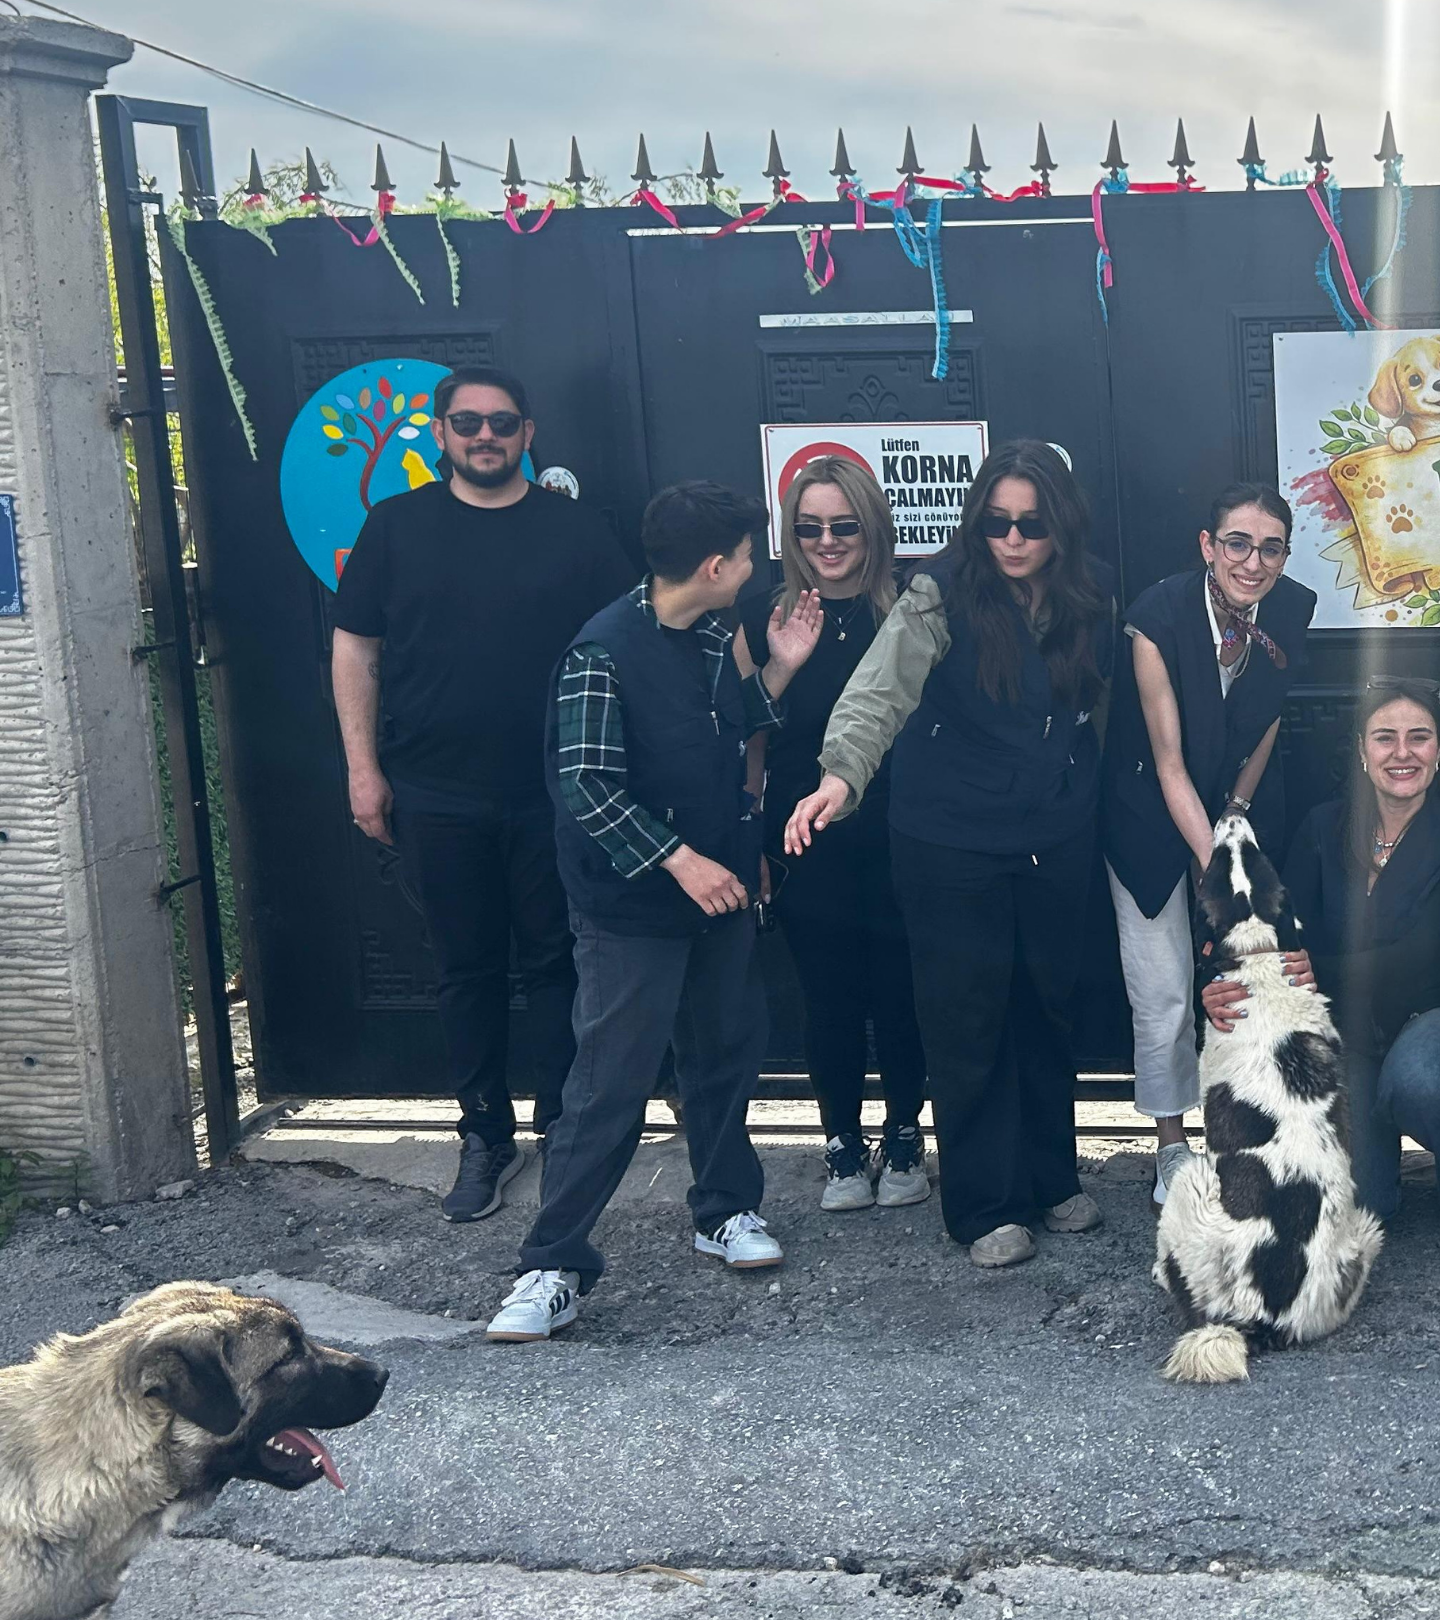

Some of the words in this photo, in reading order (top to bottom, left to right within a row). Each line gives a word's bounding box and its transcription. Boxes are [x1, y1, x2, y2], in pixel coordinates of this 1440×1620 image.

[881, 438, 920, 452] Lütfen
[882, 454, 974, 484] KORNA
[884, 487, 969, 511] ÇALMAYI
[903, 512, 921, 522] SİZİ
[924, 512, 963, 522] GÖRÜYO
[892, 525, 958, 544] EKLEYİ
